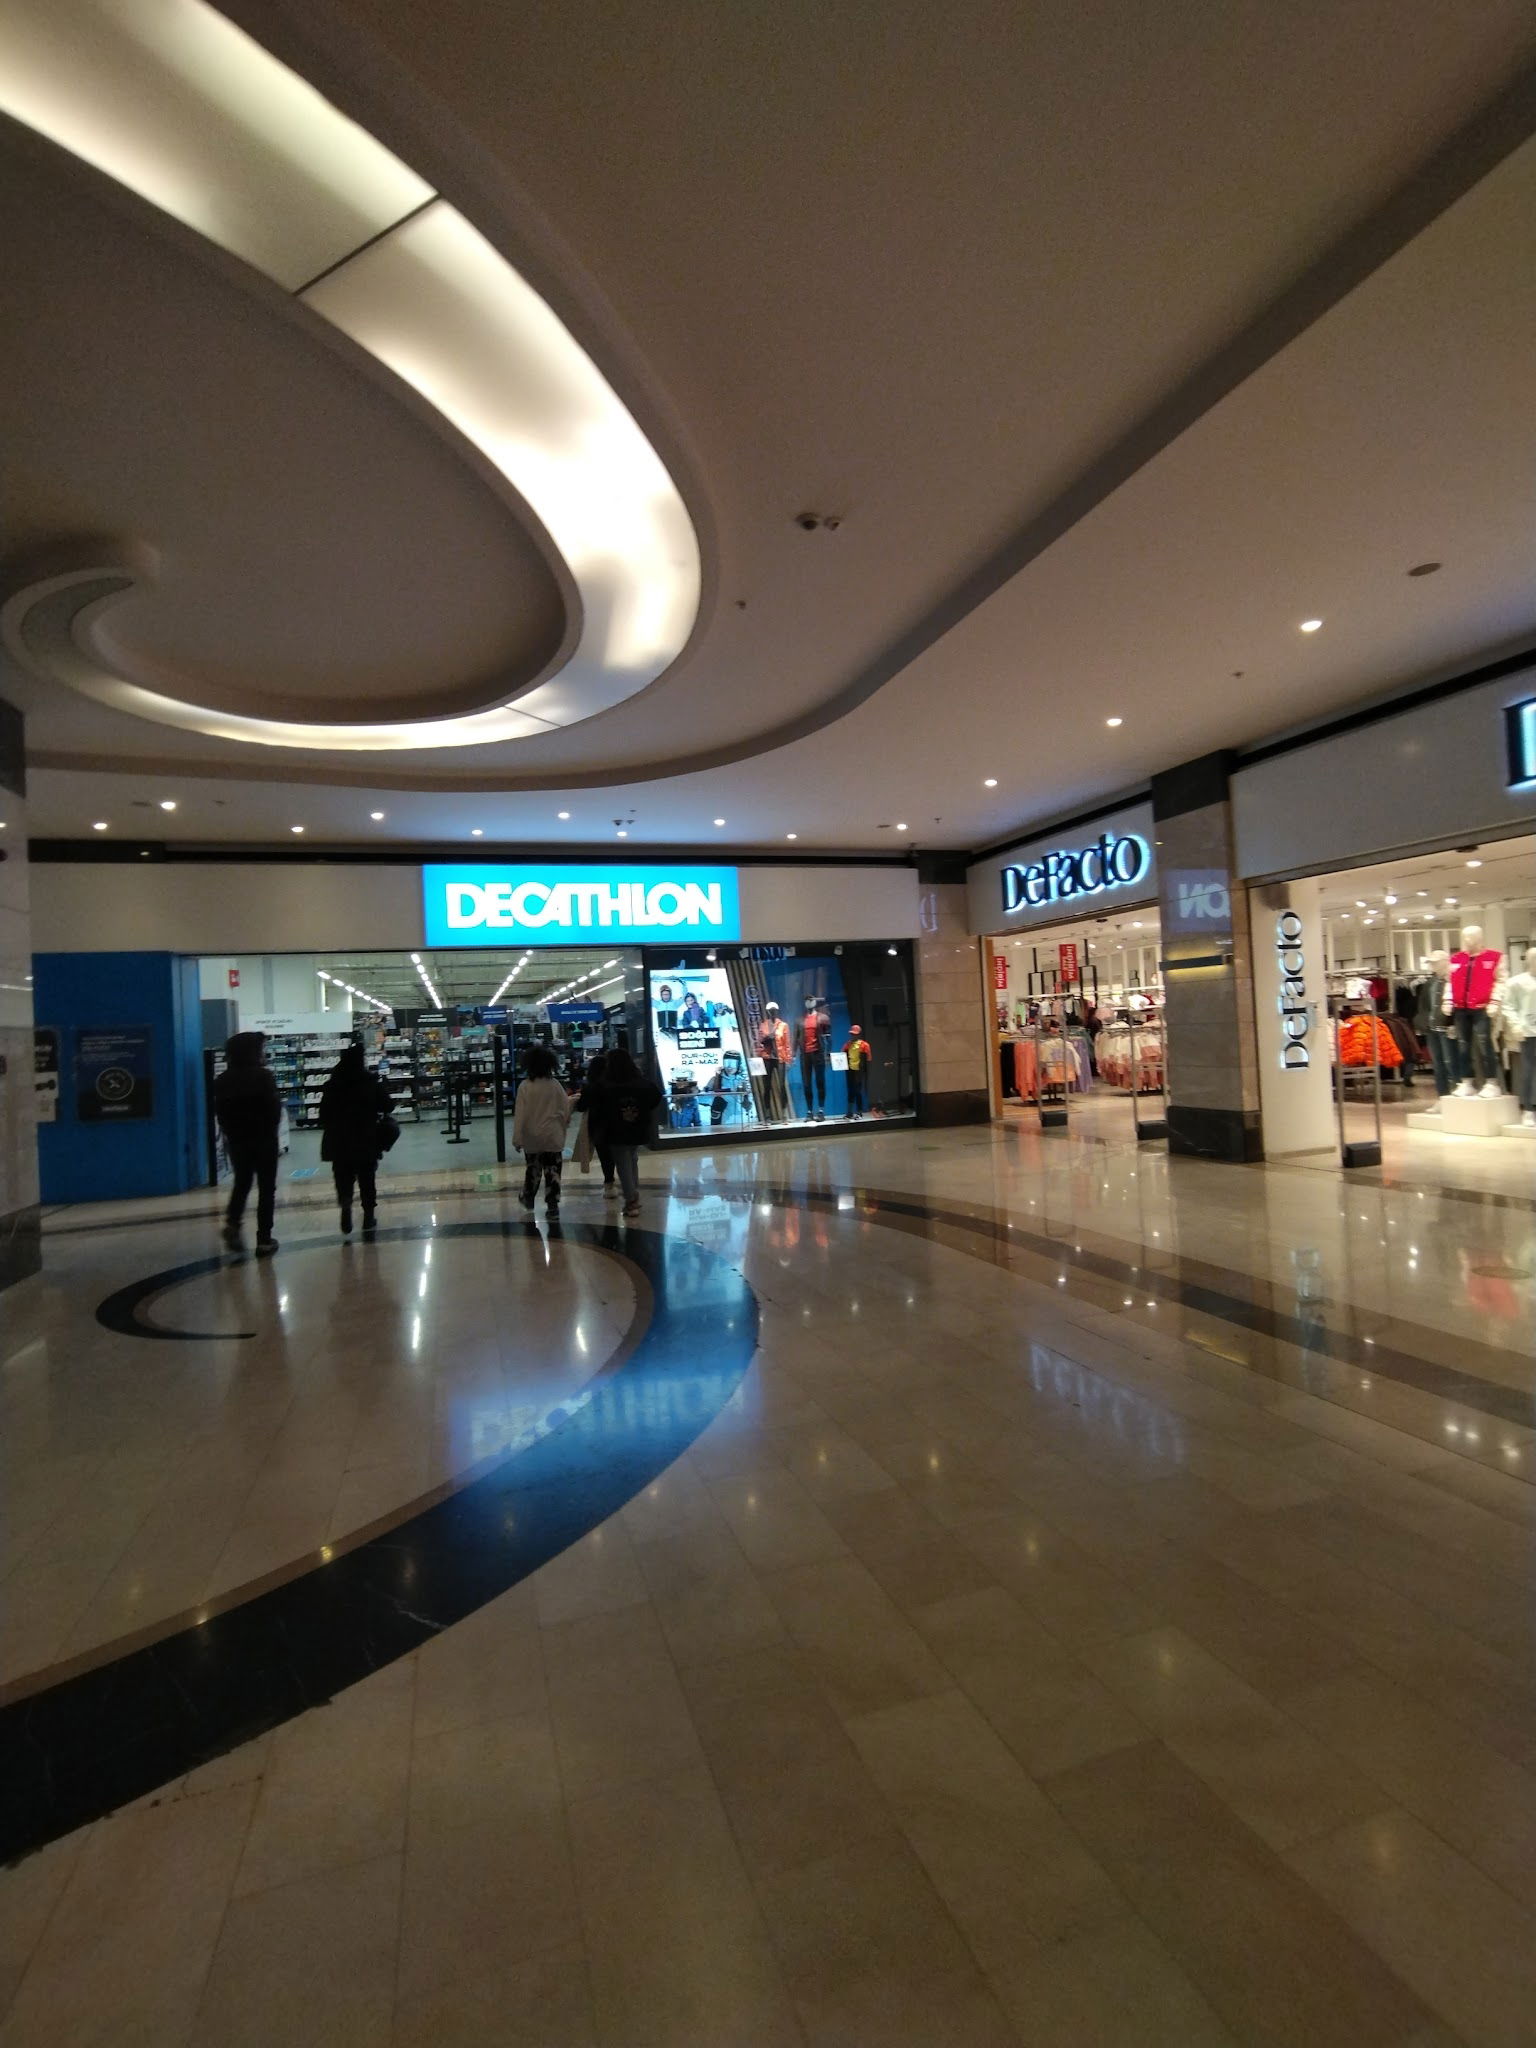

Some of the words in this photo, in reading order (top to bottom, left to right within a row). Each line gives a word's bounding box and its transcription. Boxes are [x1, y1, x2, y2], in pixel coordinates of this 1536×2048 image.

[445, 882, 723, 928] DECATHLON
[1001, 833, 1149, 914] DeFacto
[1276, 910, 1310, 1070] DeFacto
